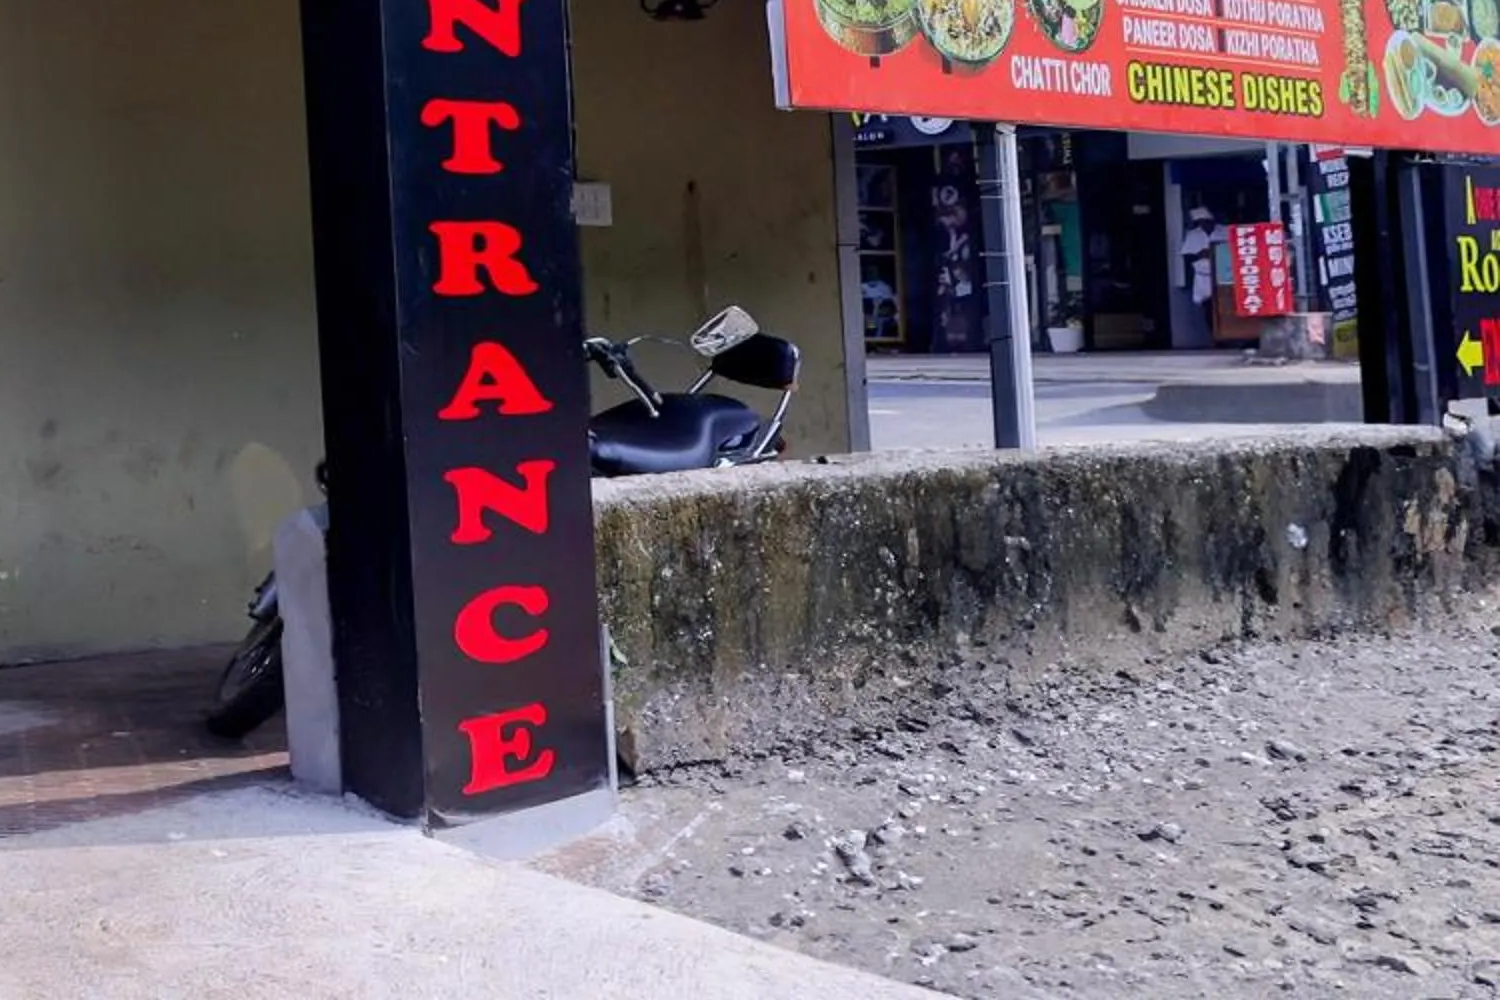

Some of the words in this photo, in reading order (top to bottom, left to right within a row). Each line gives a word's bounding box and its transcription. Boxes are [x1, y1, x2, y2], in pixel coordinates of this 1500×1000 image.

[1123, 15, 1178, 49] PANEER
[1179, 21, 1217, 54] DOSA
[1267, 0, 1325, 33] PORATHA
[1262, 33, 1320, 66] PORATHA
[1011, 55, 1069, 93] CHATTI
[1070, 60, 1112, 97] CHOR
[1128, 61, 1235, 108] CHINESE
[1241, 73, 1324, 118] DISHES
